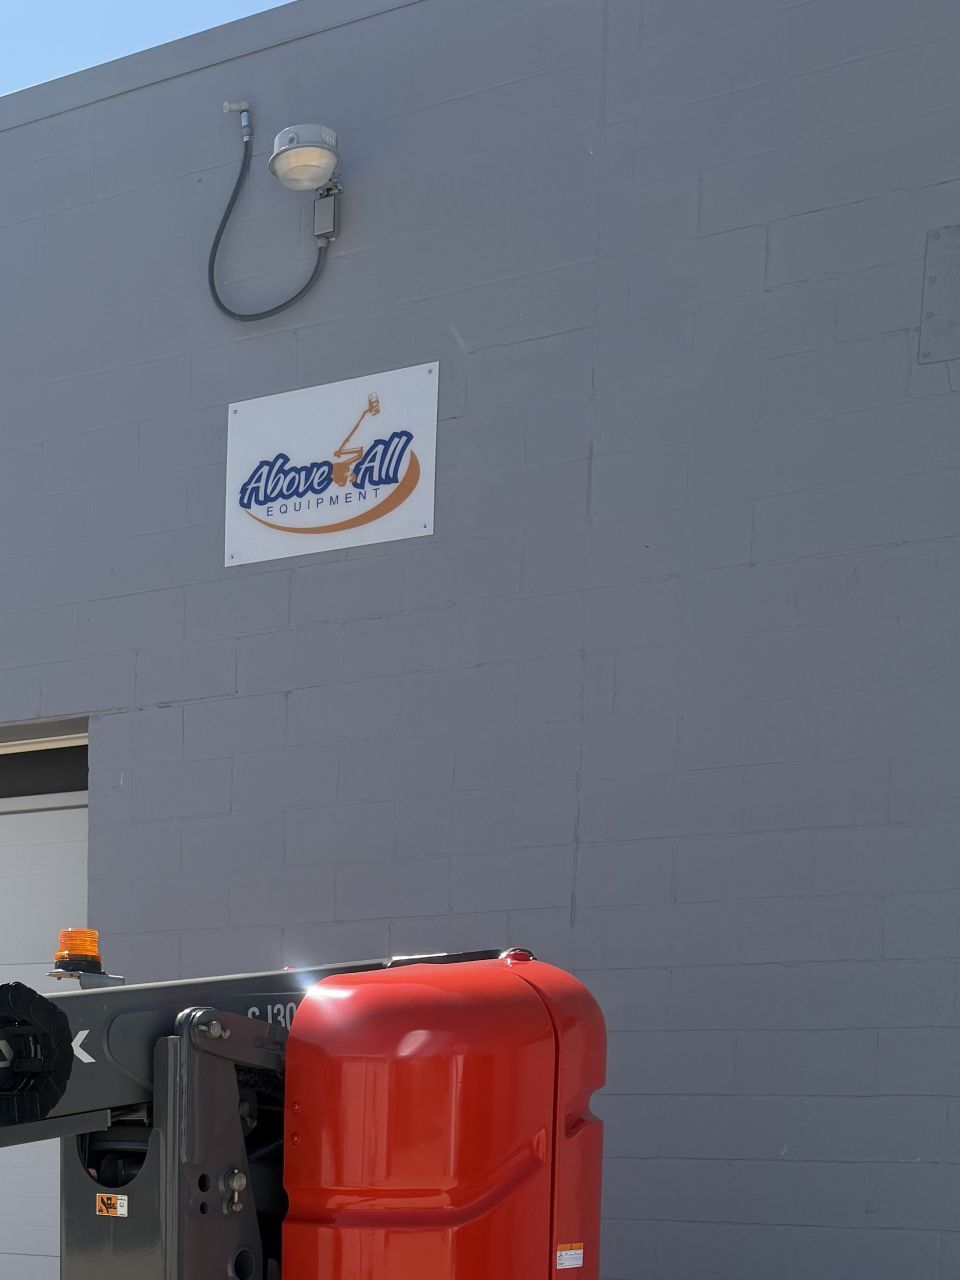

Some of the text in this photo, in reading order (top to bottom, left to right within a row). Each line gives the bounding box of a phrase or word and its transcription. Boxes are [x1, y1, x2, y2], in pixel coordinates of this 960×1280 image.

[241, 432, 413, 508] Above All
[267, 488, 380, 516] EQUIPMENT
